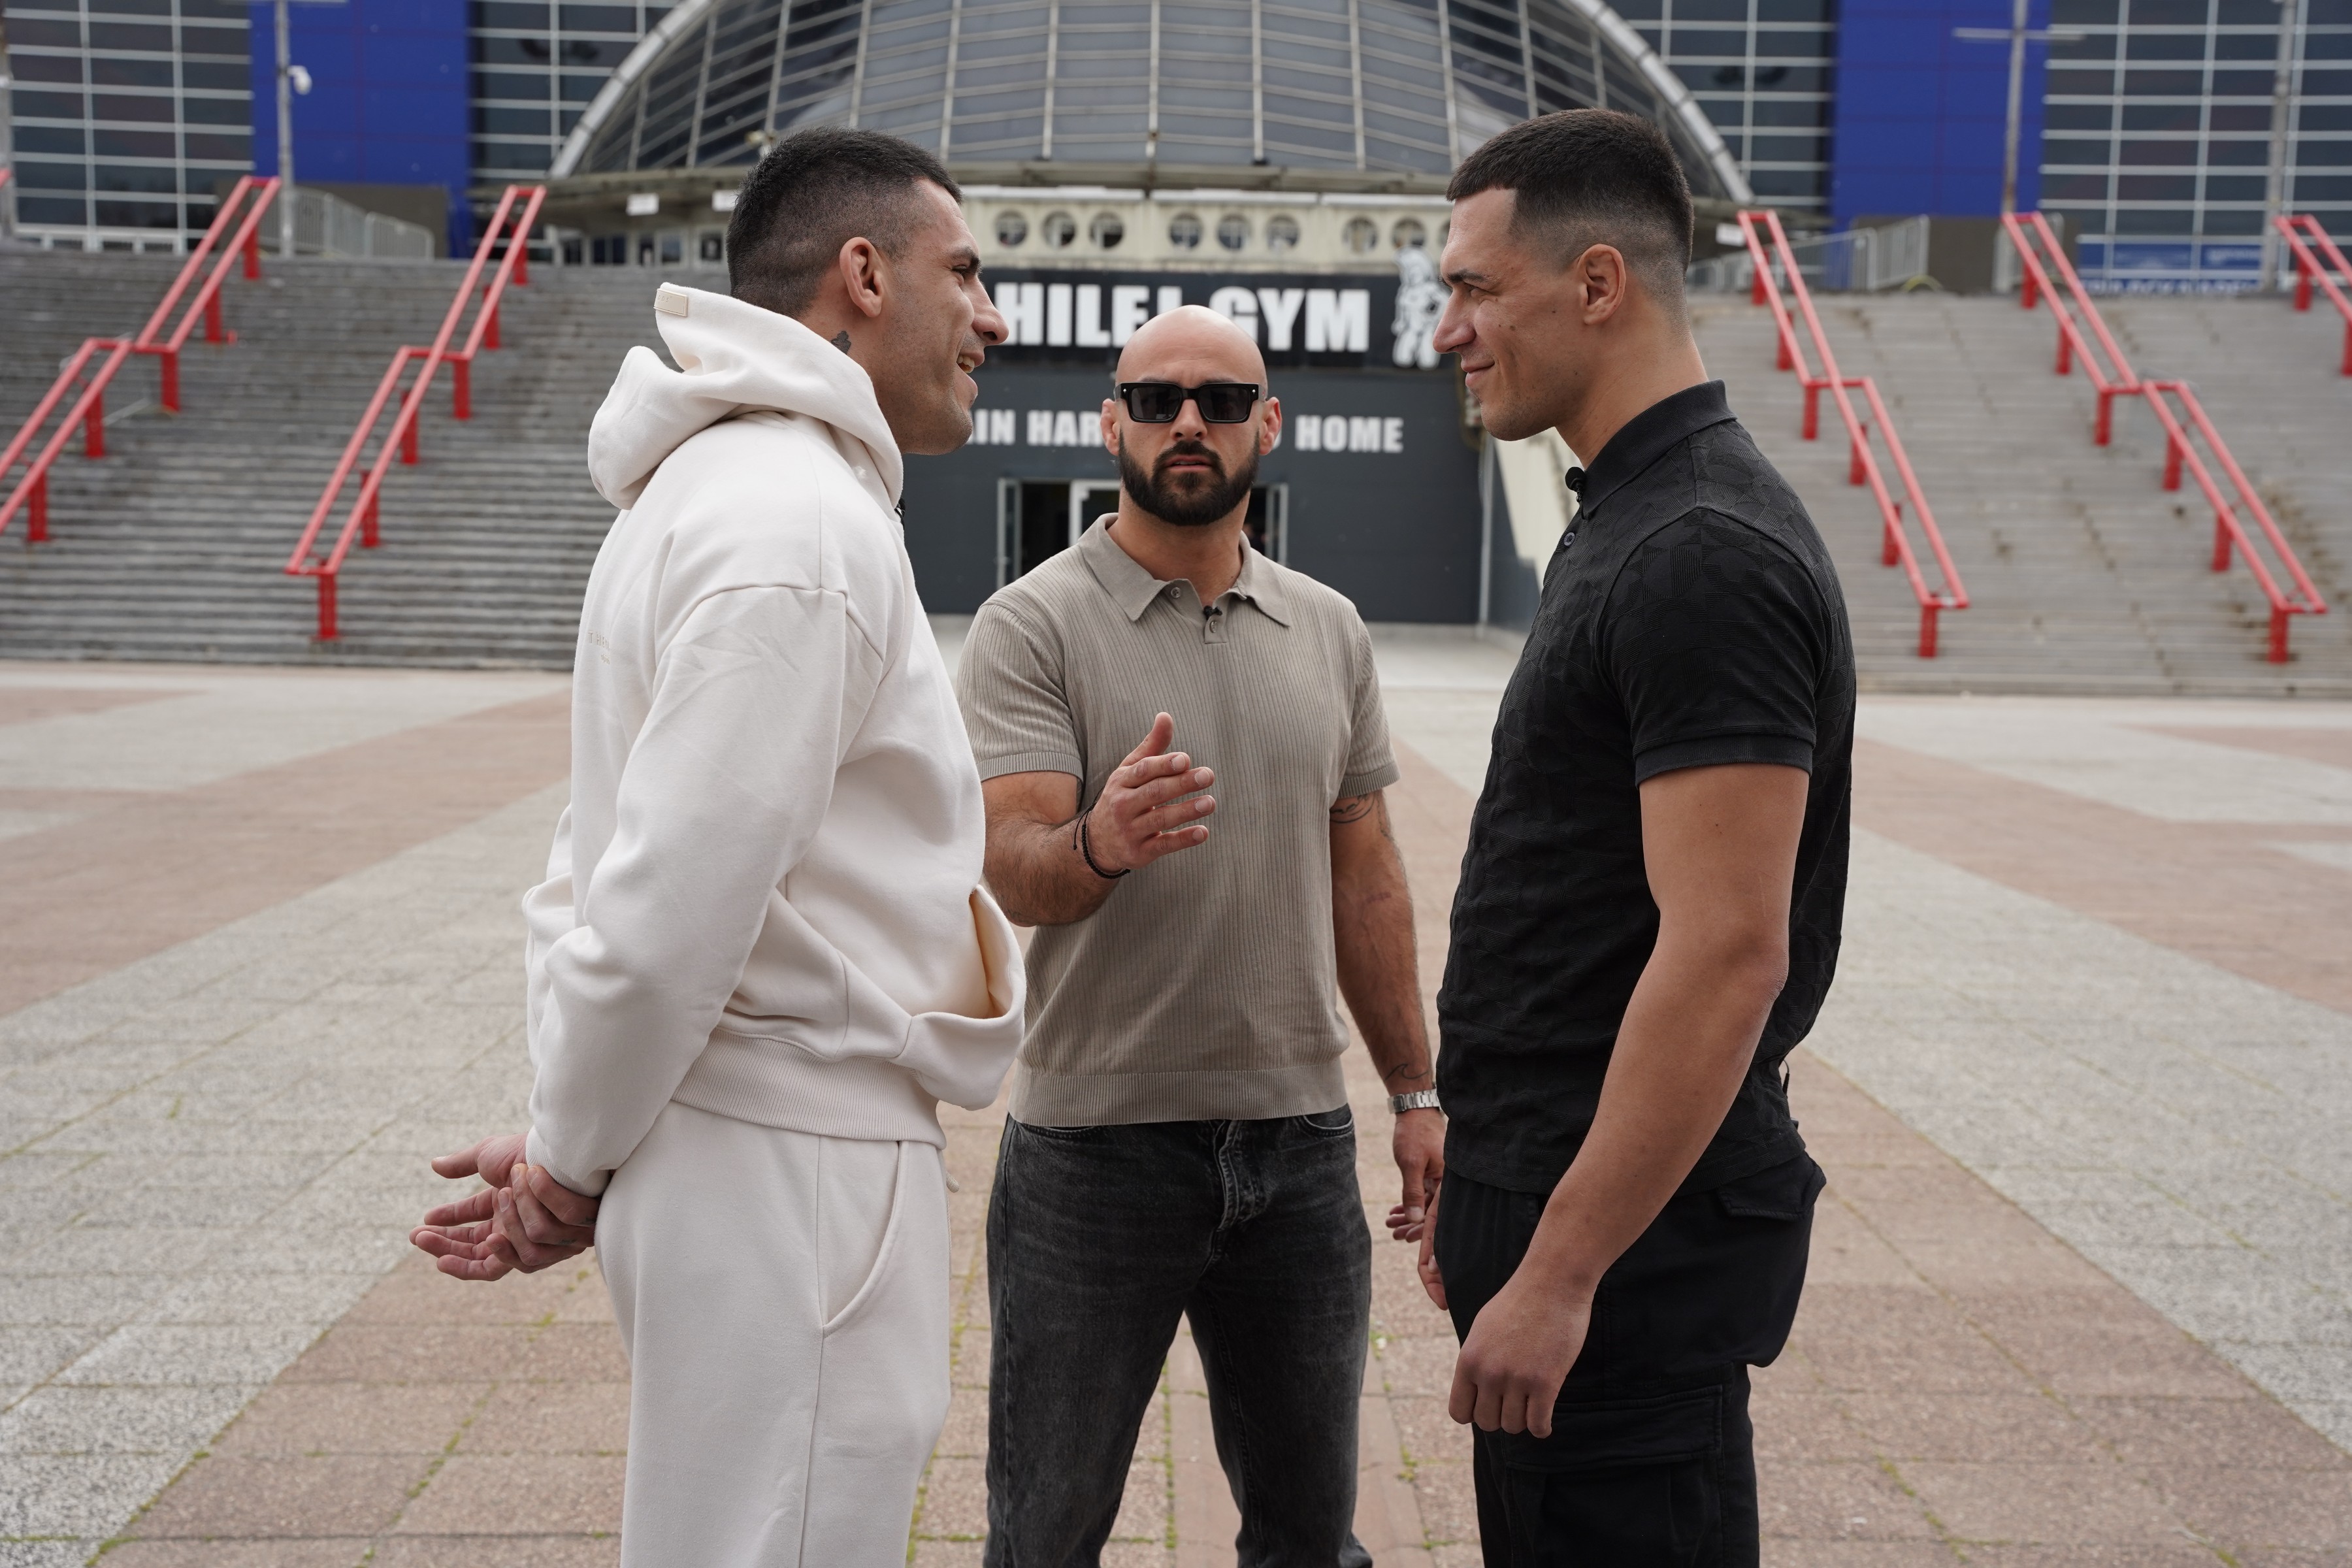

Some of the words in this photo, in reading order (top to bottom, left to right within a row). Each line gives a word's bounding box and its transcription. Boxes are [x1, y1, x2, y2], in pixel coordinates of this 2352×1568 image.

[994, 282, 1183, 348] HILE
[1209, 286, 1371, 353] GYM
[967, 408, 1017, 446] IN
[1026, 409, 1104, 448] HAR
[1294, 414, 1405, 454] HOME
